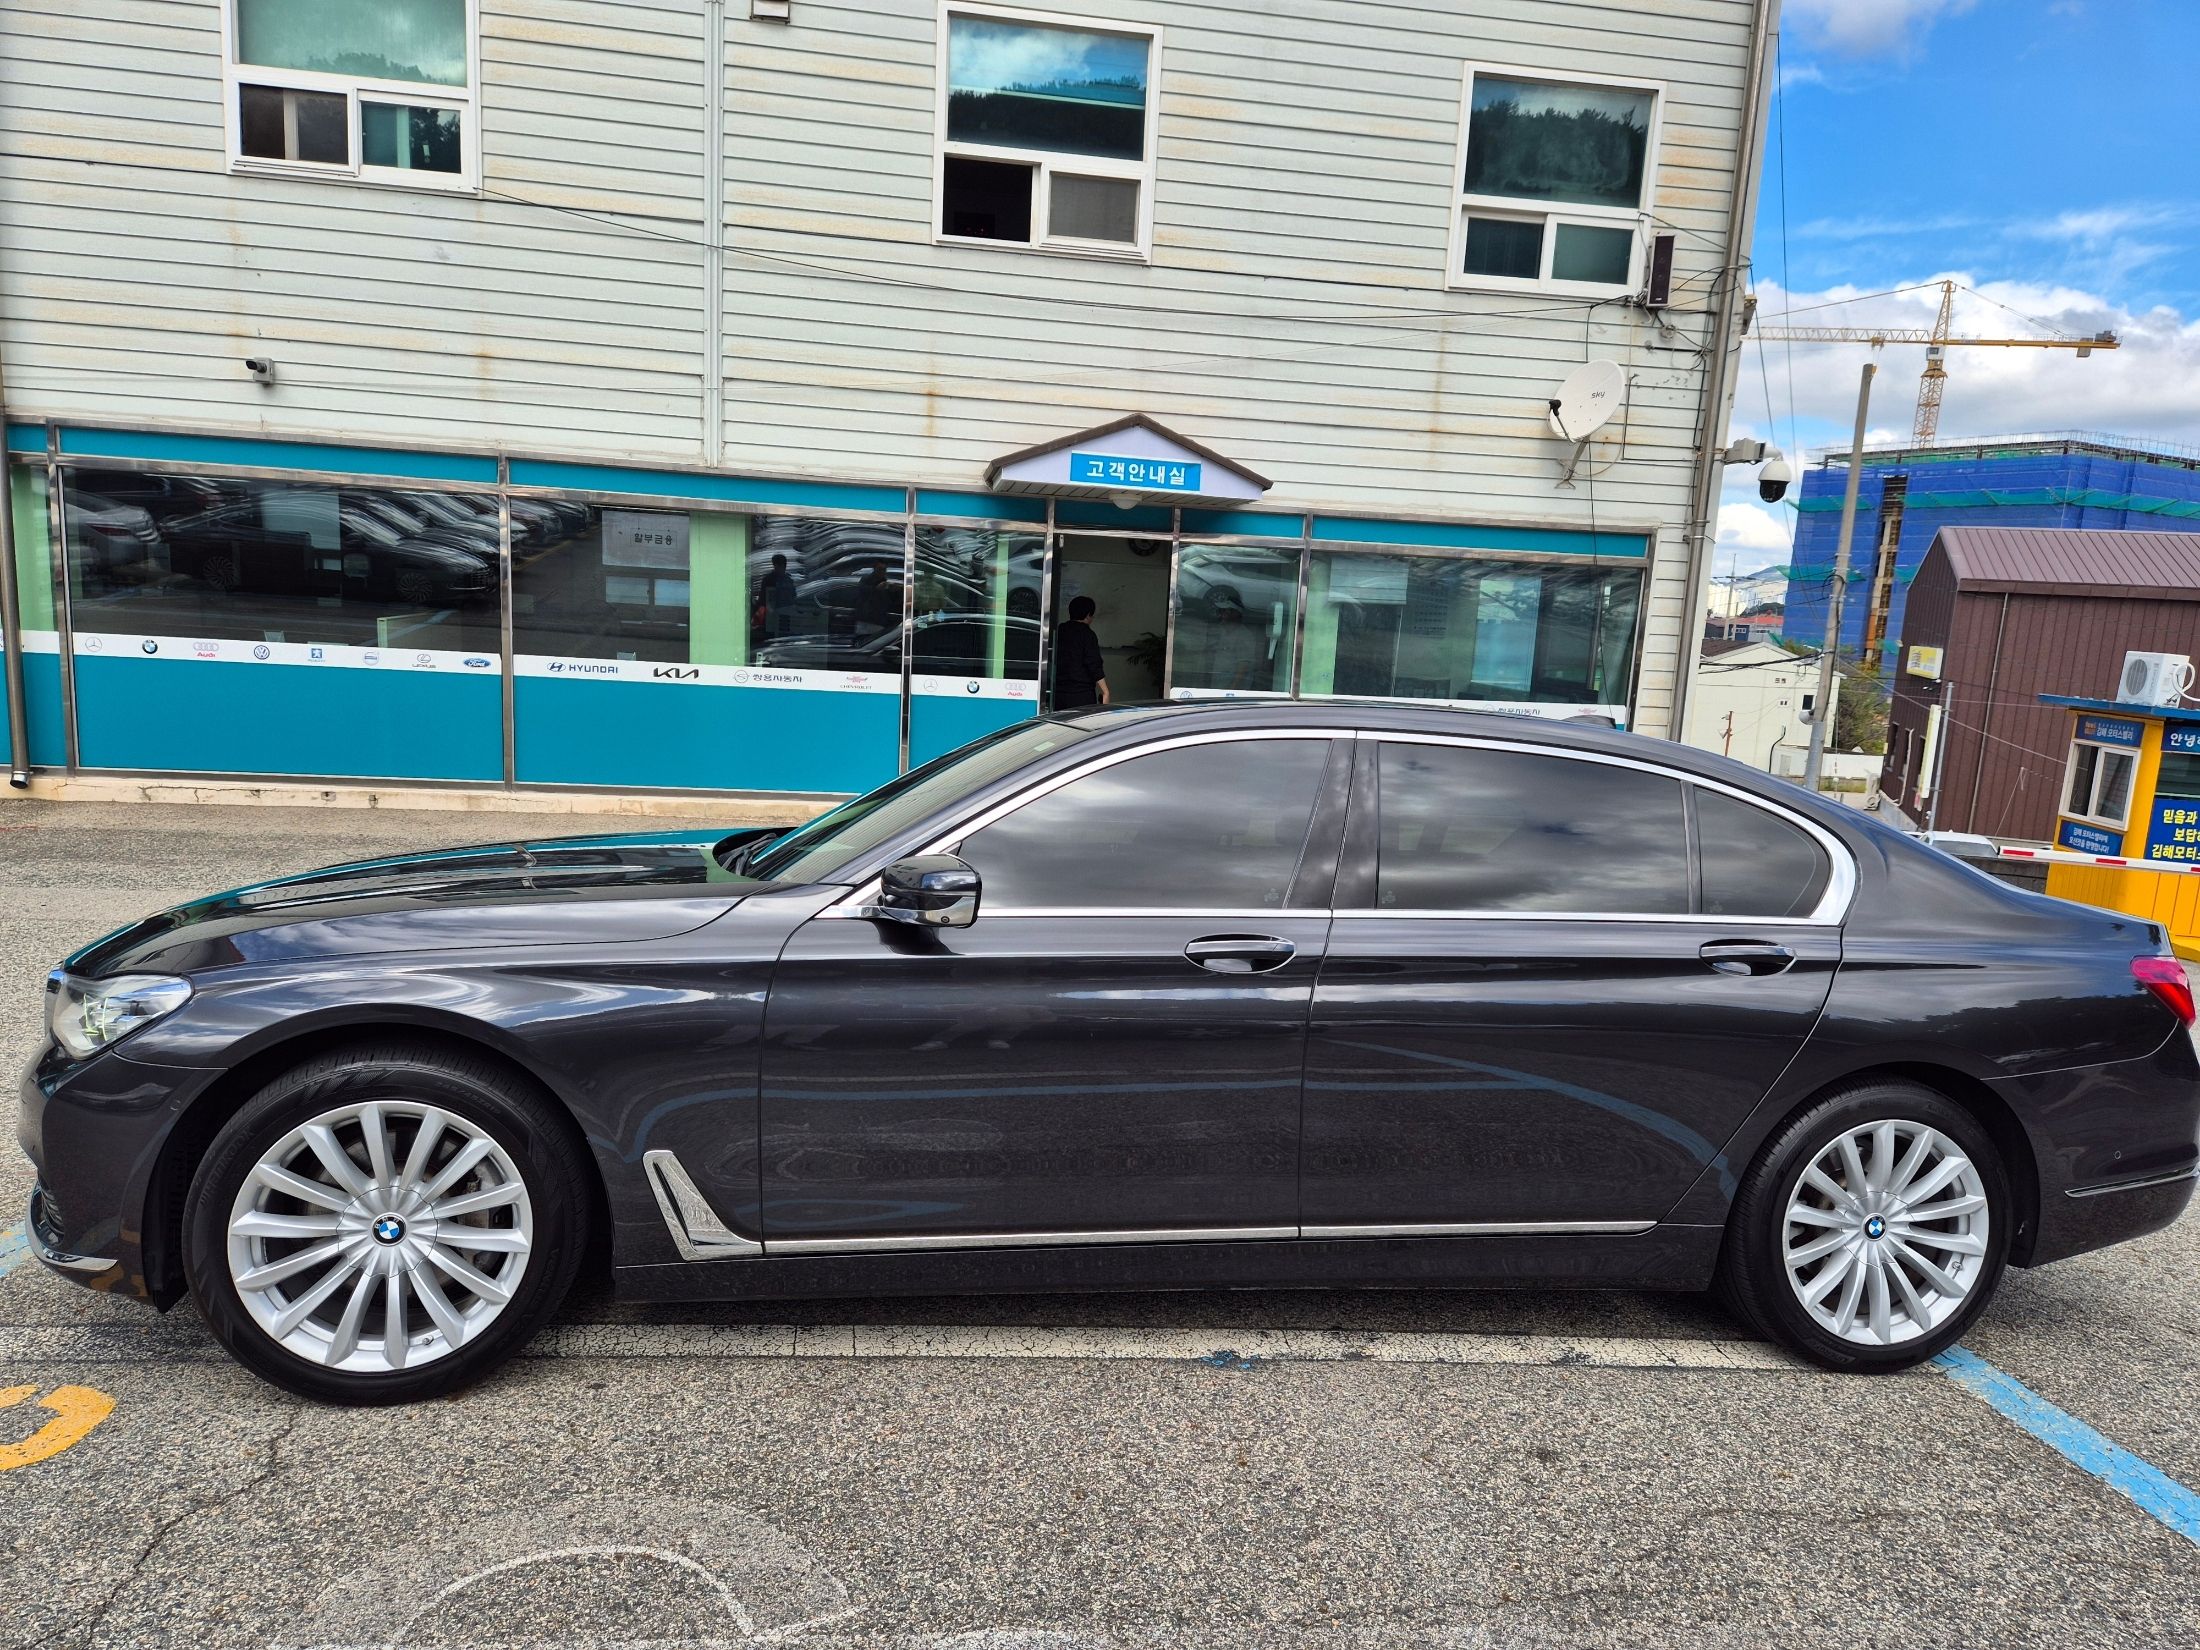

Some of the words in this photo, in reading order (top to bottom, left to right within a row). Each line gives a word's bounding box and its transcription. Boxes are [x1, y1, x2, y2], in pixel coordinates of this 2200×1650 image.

[1087, 460, 1186, 485] 고객안내실
[569, 664, 618, 674] HYUNDAI
[653, 667, 699, 679] KIA
[2163, 809, 2198, 825] 믿음과
